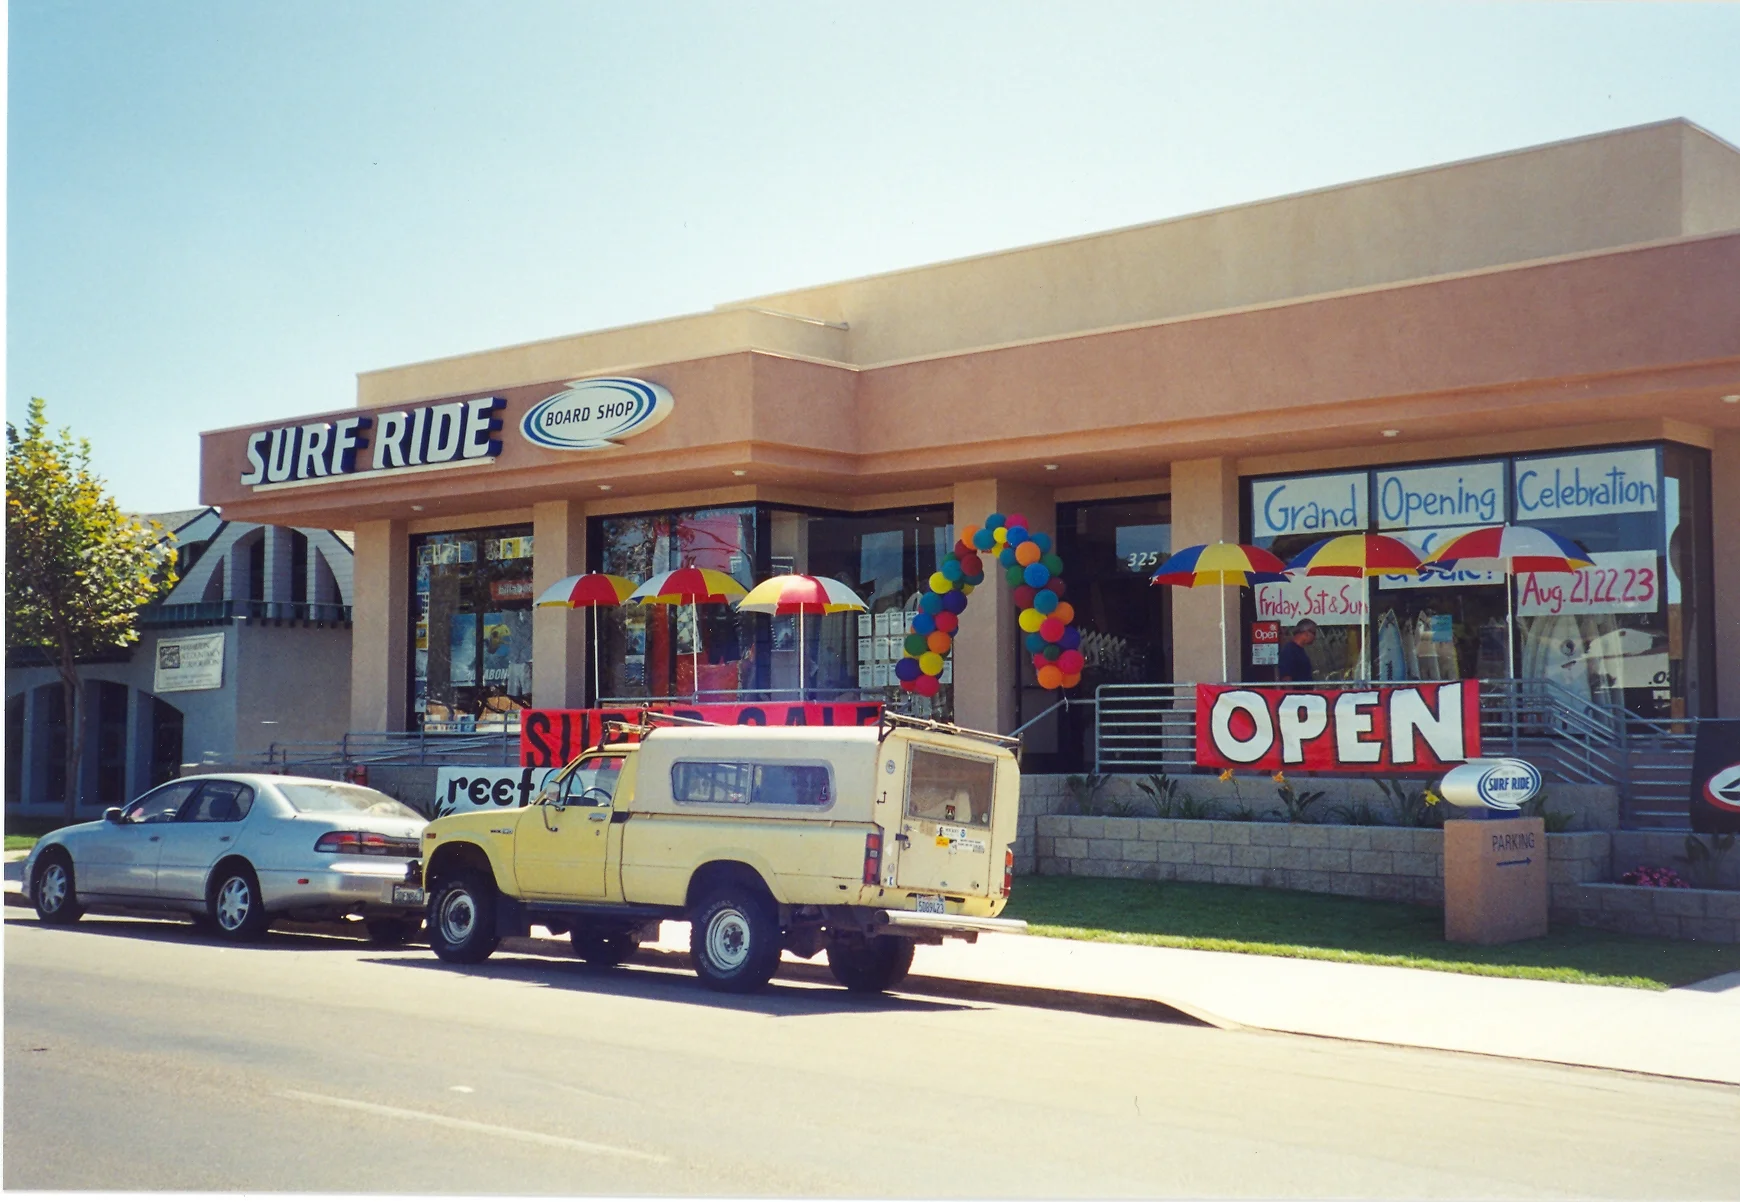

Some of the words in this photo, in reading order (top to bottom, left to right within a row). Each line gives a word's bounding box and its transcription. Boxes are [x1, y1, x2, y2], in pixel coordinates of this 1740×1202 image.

[545, 406, 590, 427] BOARD
[597, 401, 634, 420] SHOP
[241, 416, 370, 486] SURF
[372, 396, 506, 470] RIDE
[1263, 483, 1358, 532] Grand
[1381, 476, 1496, 526] Opening
[1517, 465, 1657, 511] Celebration
[1127, 551, 1158, 567] 325
[1304, 585, 1328, 616] Sat
[1521, 571, 1567, 614] Aug.
[1254, 629, 1278, 641] Open
[1210, 682, 1465, 764] OPEN
[448, 768, 535, 806] reef
[1488, 777, 1510, 791] SURF
[1511, 776, 1531, 791] RIDE
[1491, 832, 1536, 852] PARKING
